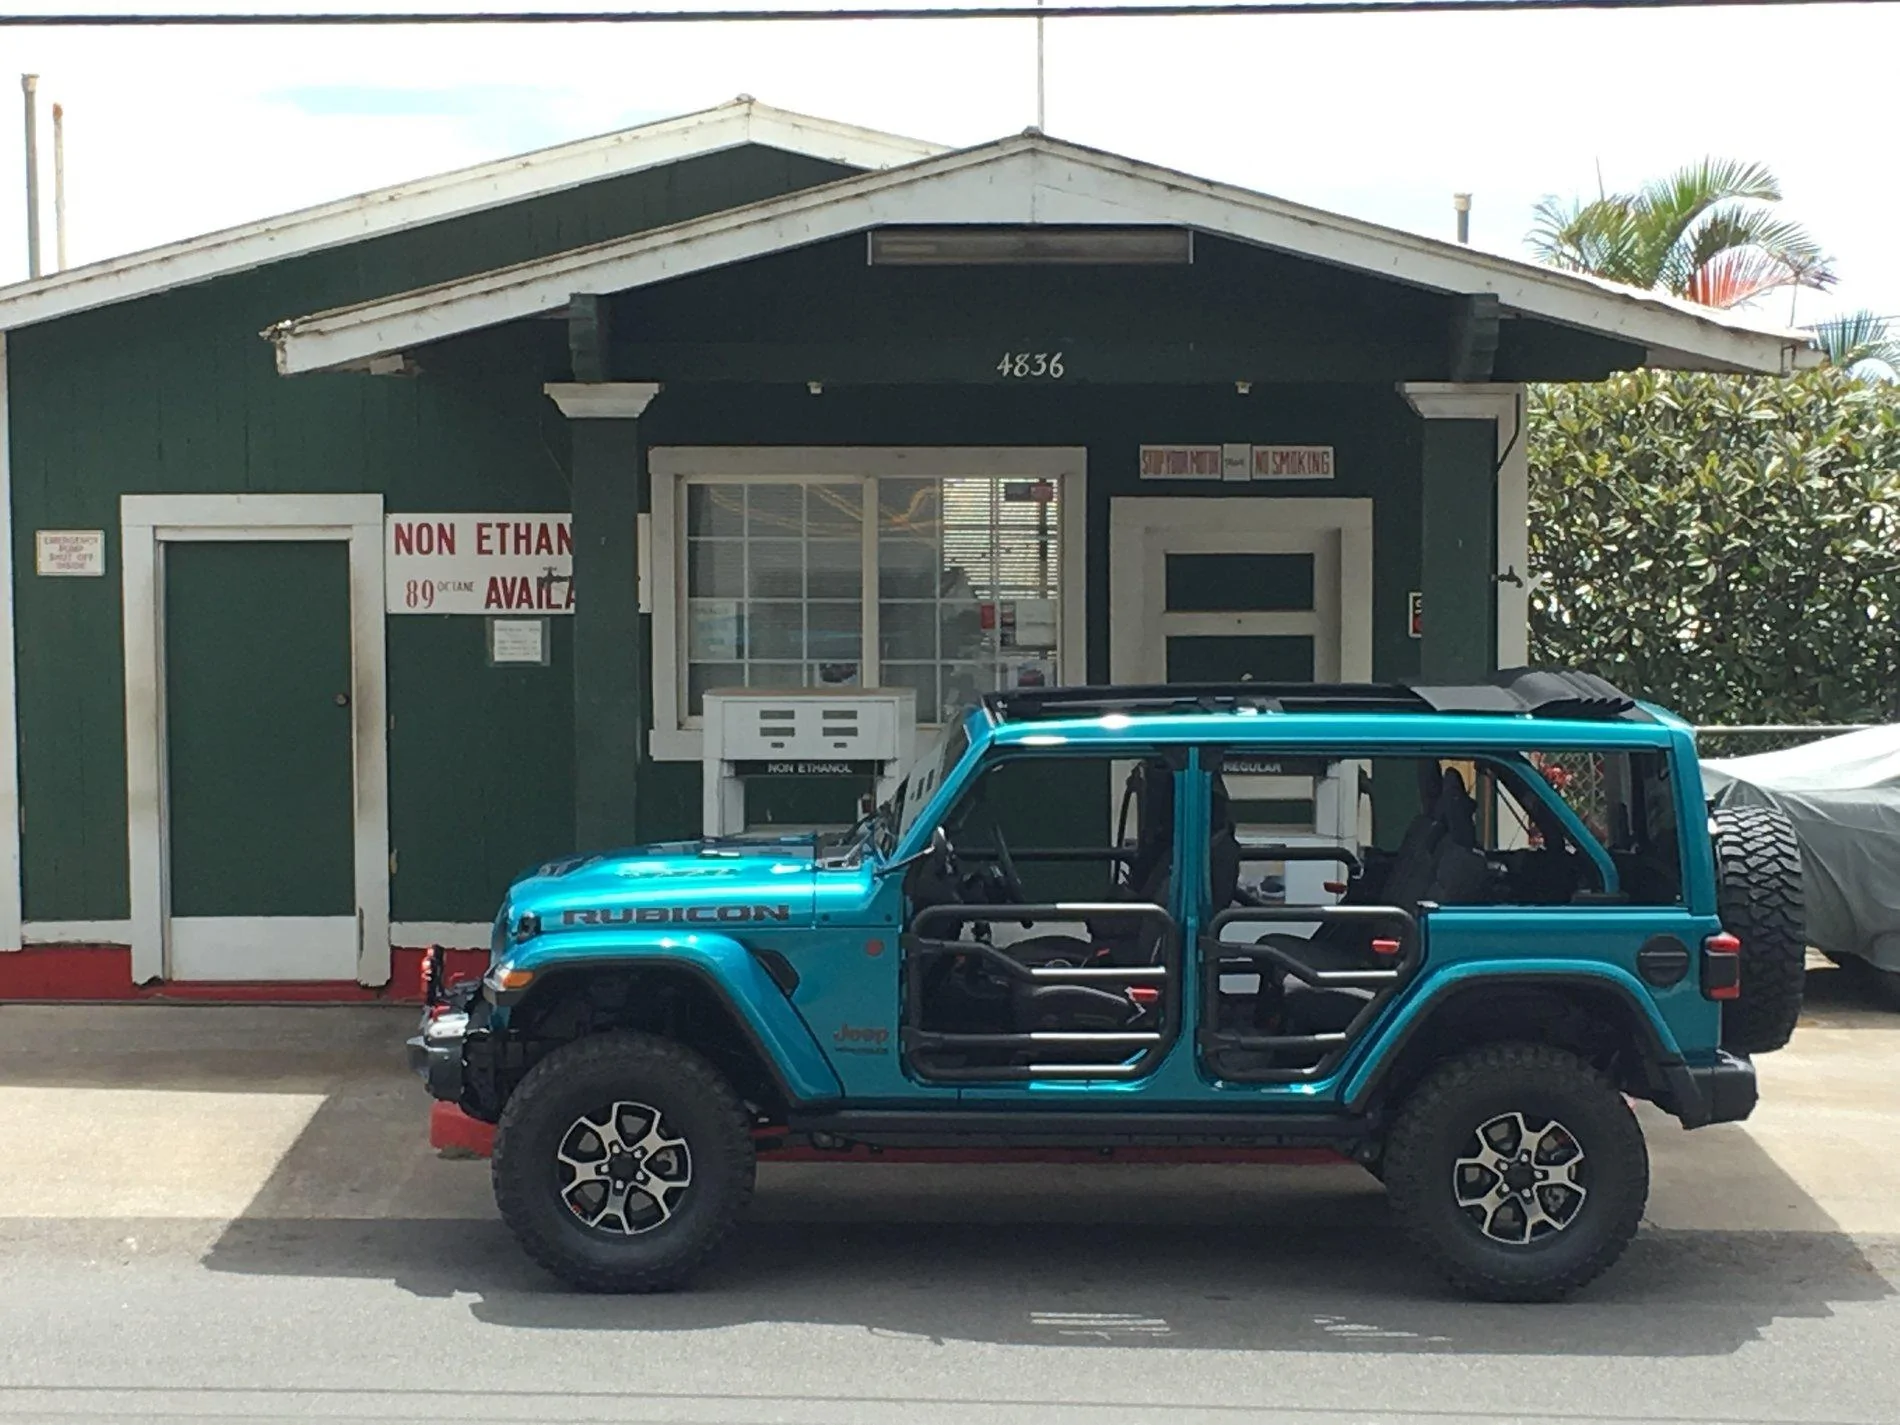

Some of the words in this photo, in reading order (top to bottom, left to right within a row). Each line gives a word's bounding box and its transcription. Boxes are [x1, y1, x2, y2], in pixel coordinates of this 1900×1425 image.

[997, 352, 1064, 378] 4836
[1272, 450, 1331, 475] SMOKING
[394, 522, 456, 555] NON
[406, 579, 434, 609] 89
[437, 581, 475, 592] OCTANE
[768, 763, 794, 773] NON
[797, 763, 852, 773] ETHANOL
[1223, 762, 1281, 773] REGULAR
[563, 905, 790, 925] RUBICON
[833, 1023, 889, 1045] Jeep
